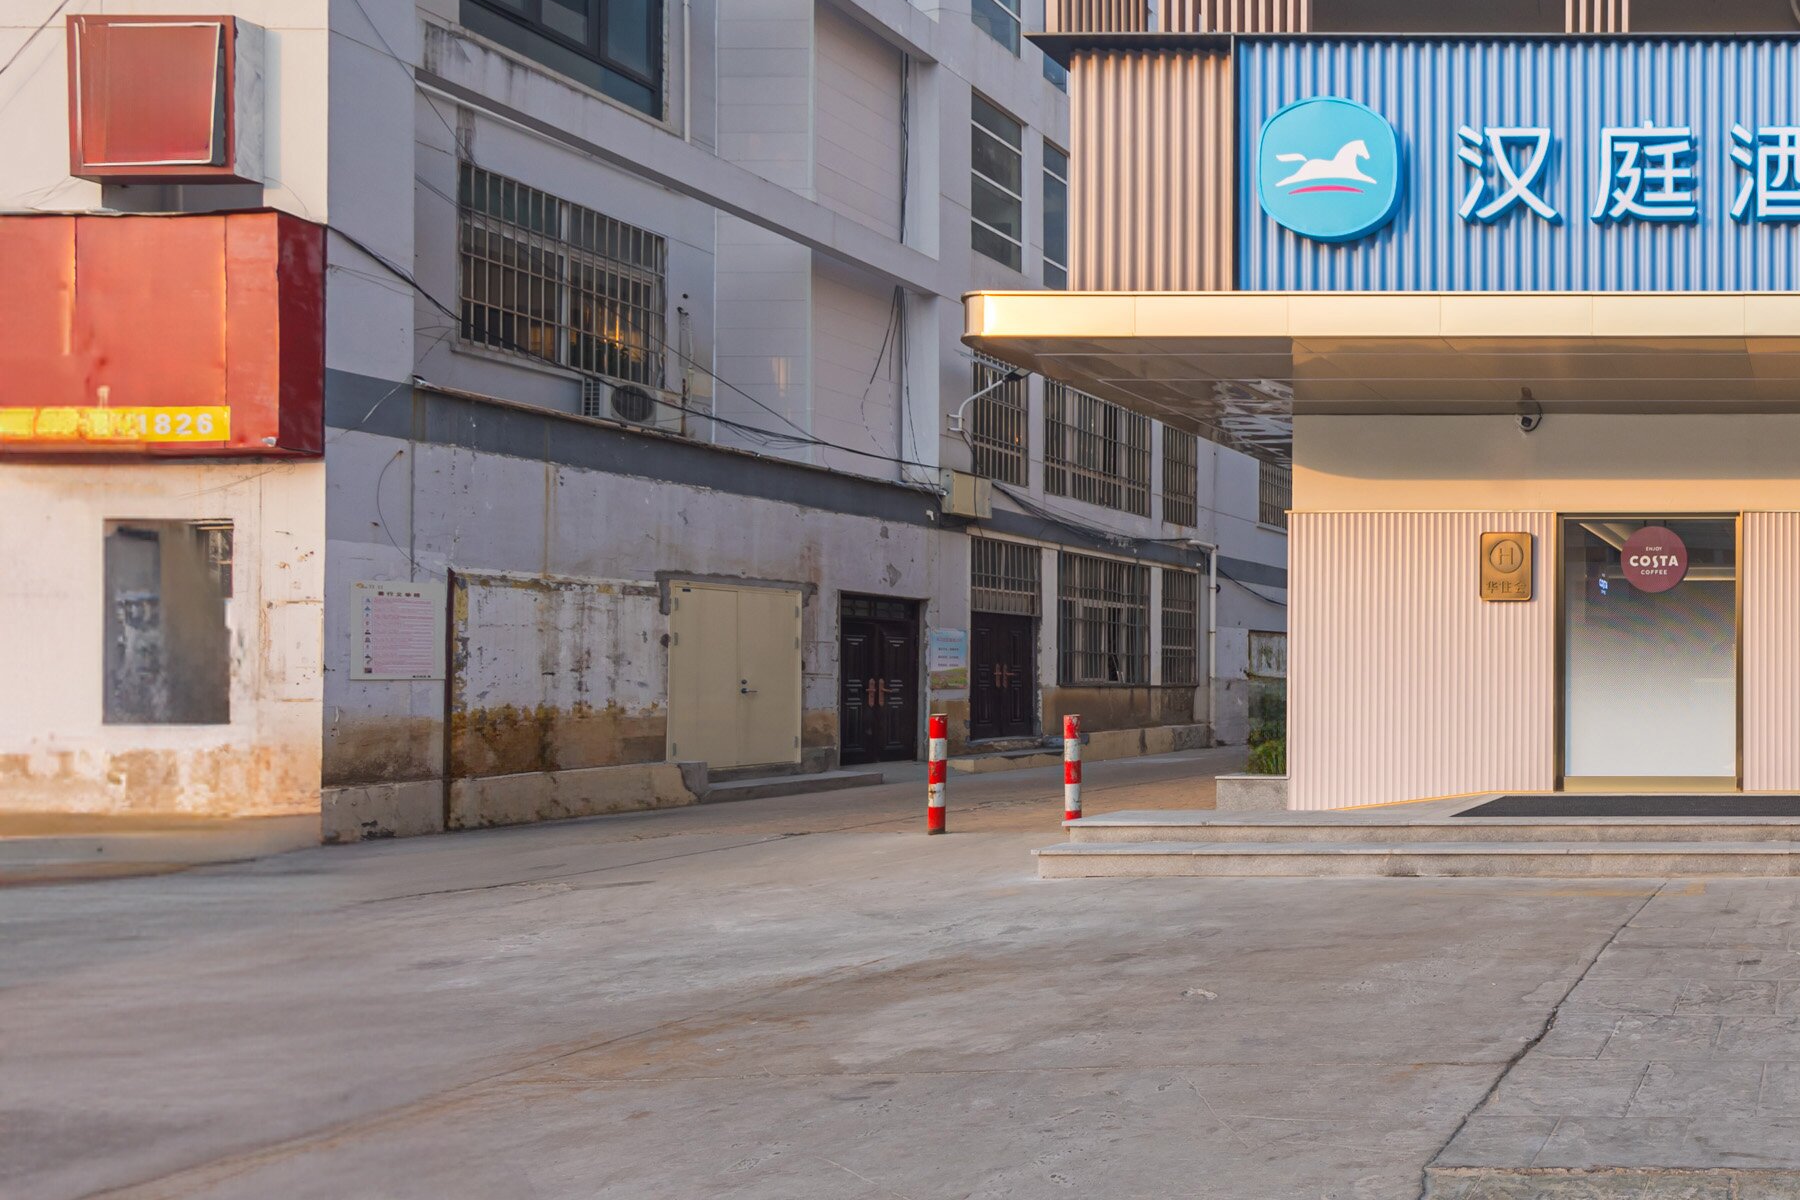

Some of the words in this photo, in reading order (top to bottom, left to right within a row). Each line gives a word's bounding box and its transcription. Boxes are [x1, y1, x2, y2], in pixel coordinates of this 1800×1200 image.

[1629, 555, 1679, 569] COSTA
[1486, 580, 1527, 594] 华住会
